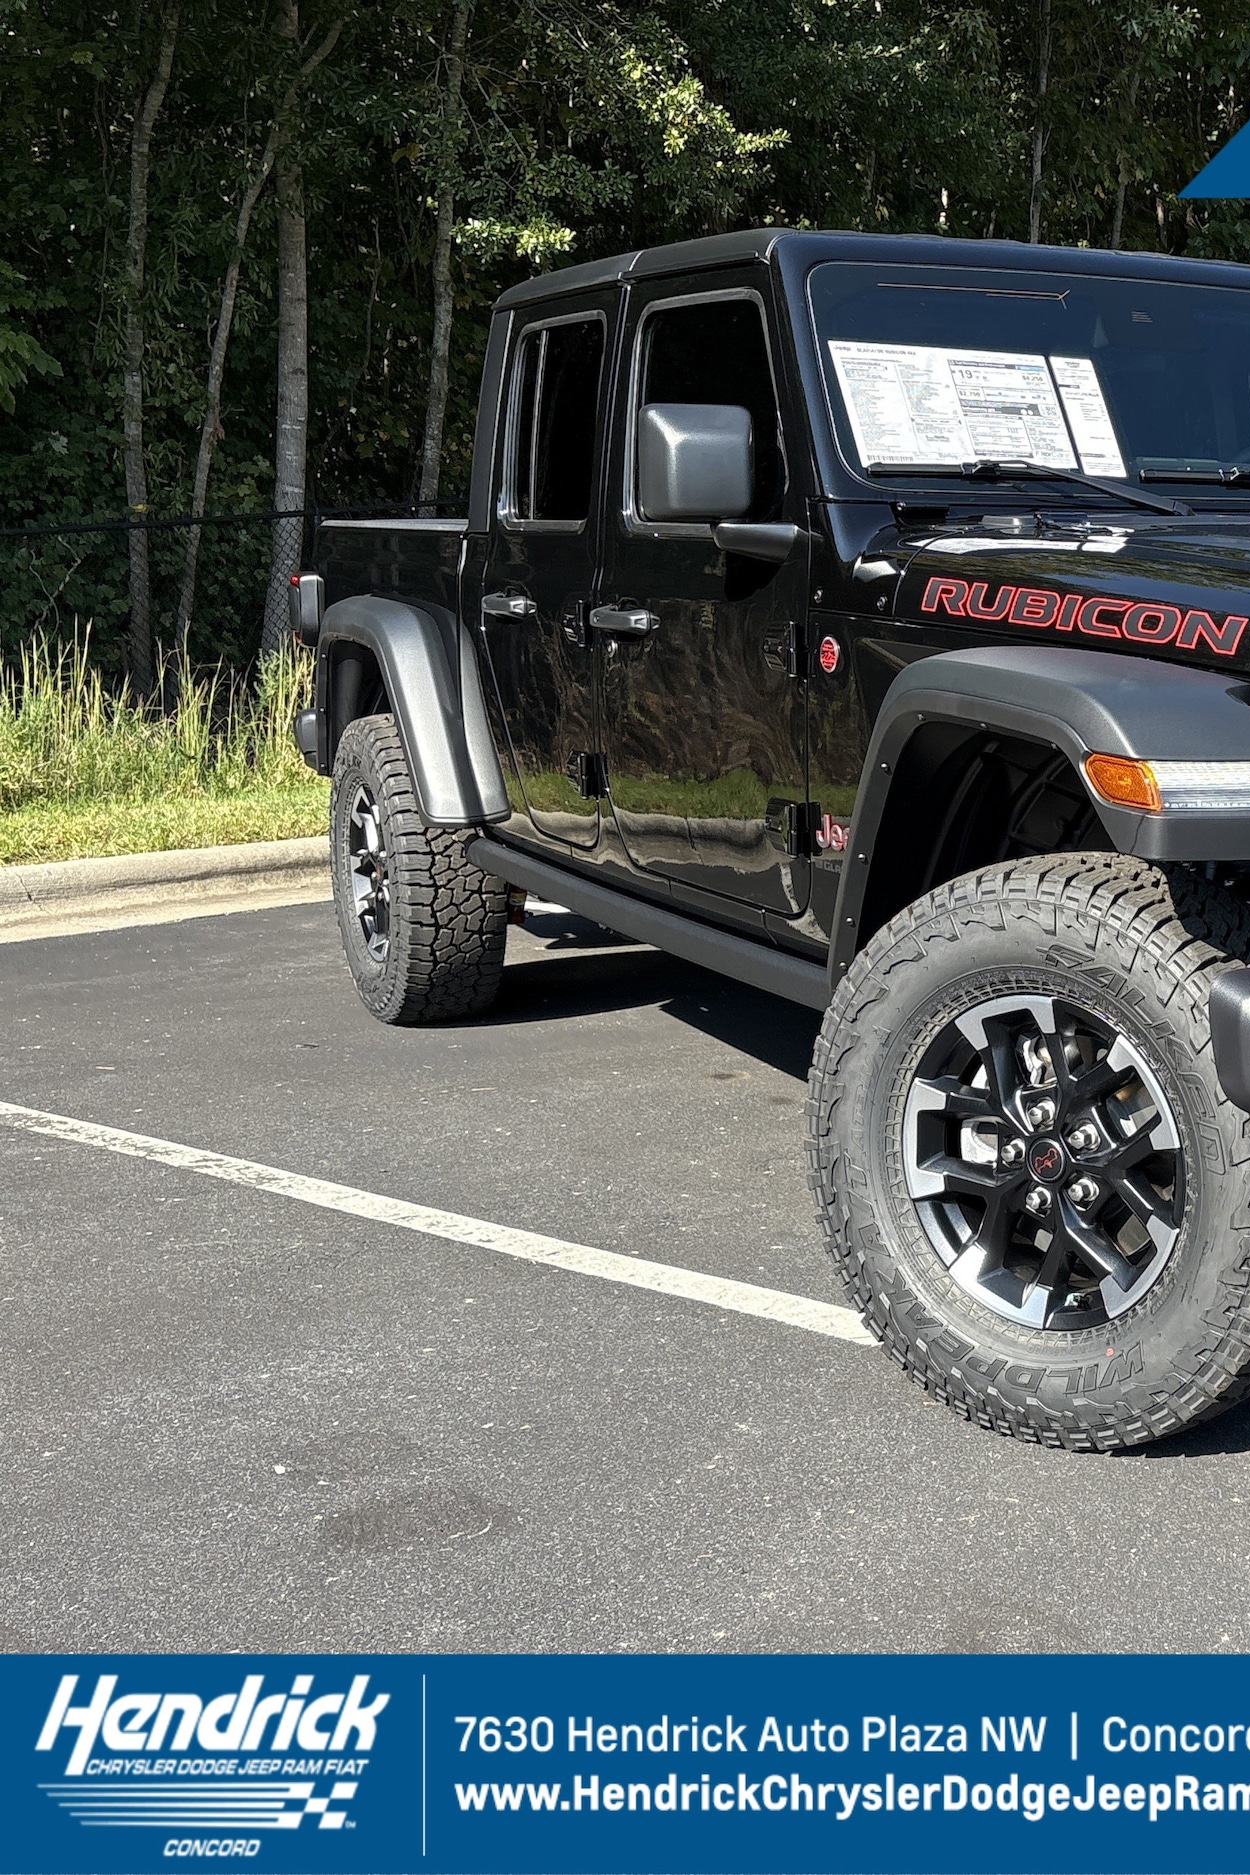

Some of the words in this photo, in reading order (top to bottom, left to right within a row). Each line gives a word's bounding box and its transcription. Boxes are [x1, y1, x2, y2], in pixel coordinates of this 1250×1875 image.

[921, 576, 1249, 656] RUBICON
[1036, 942, 1226, 1176] FALKEN
[875, 1266, 1145, 1395] WILDPEAK
